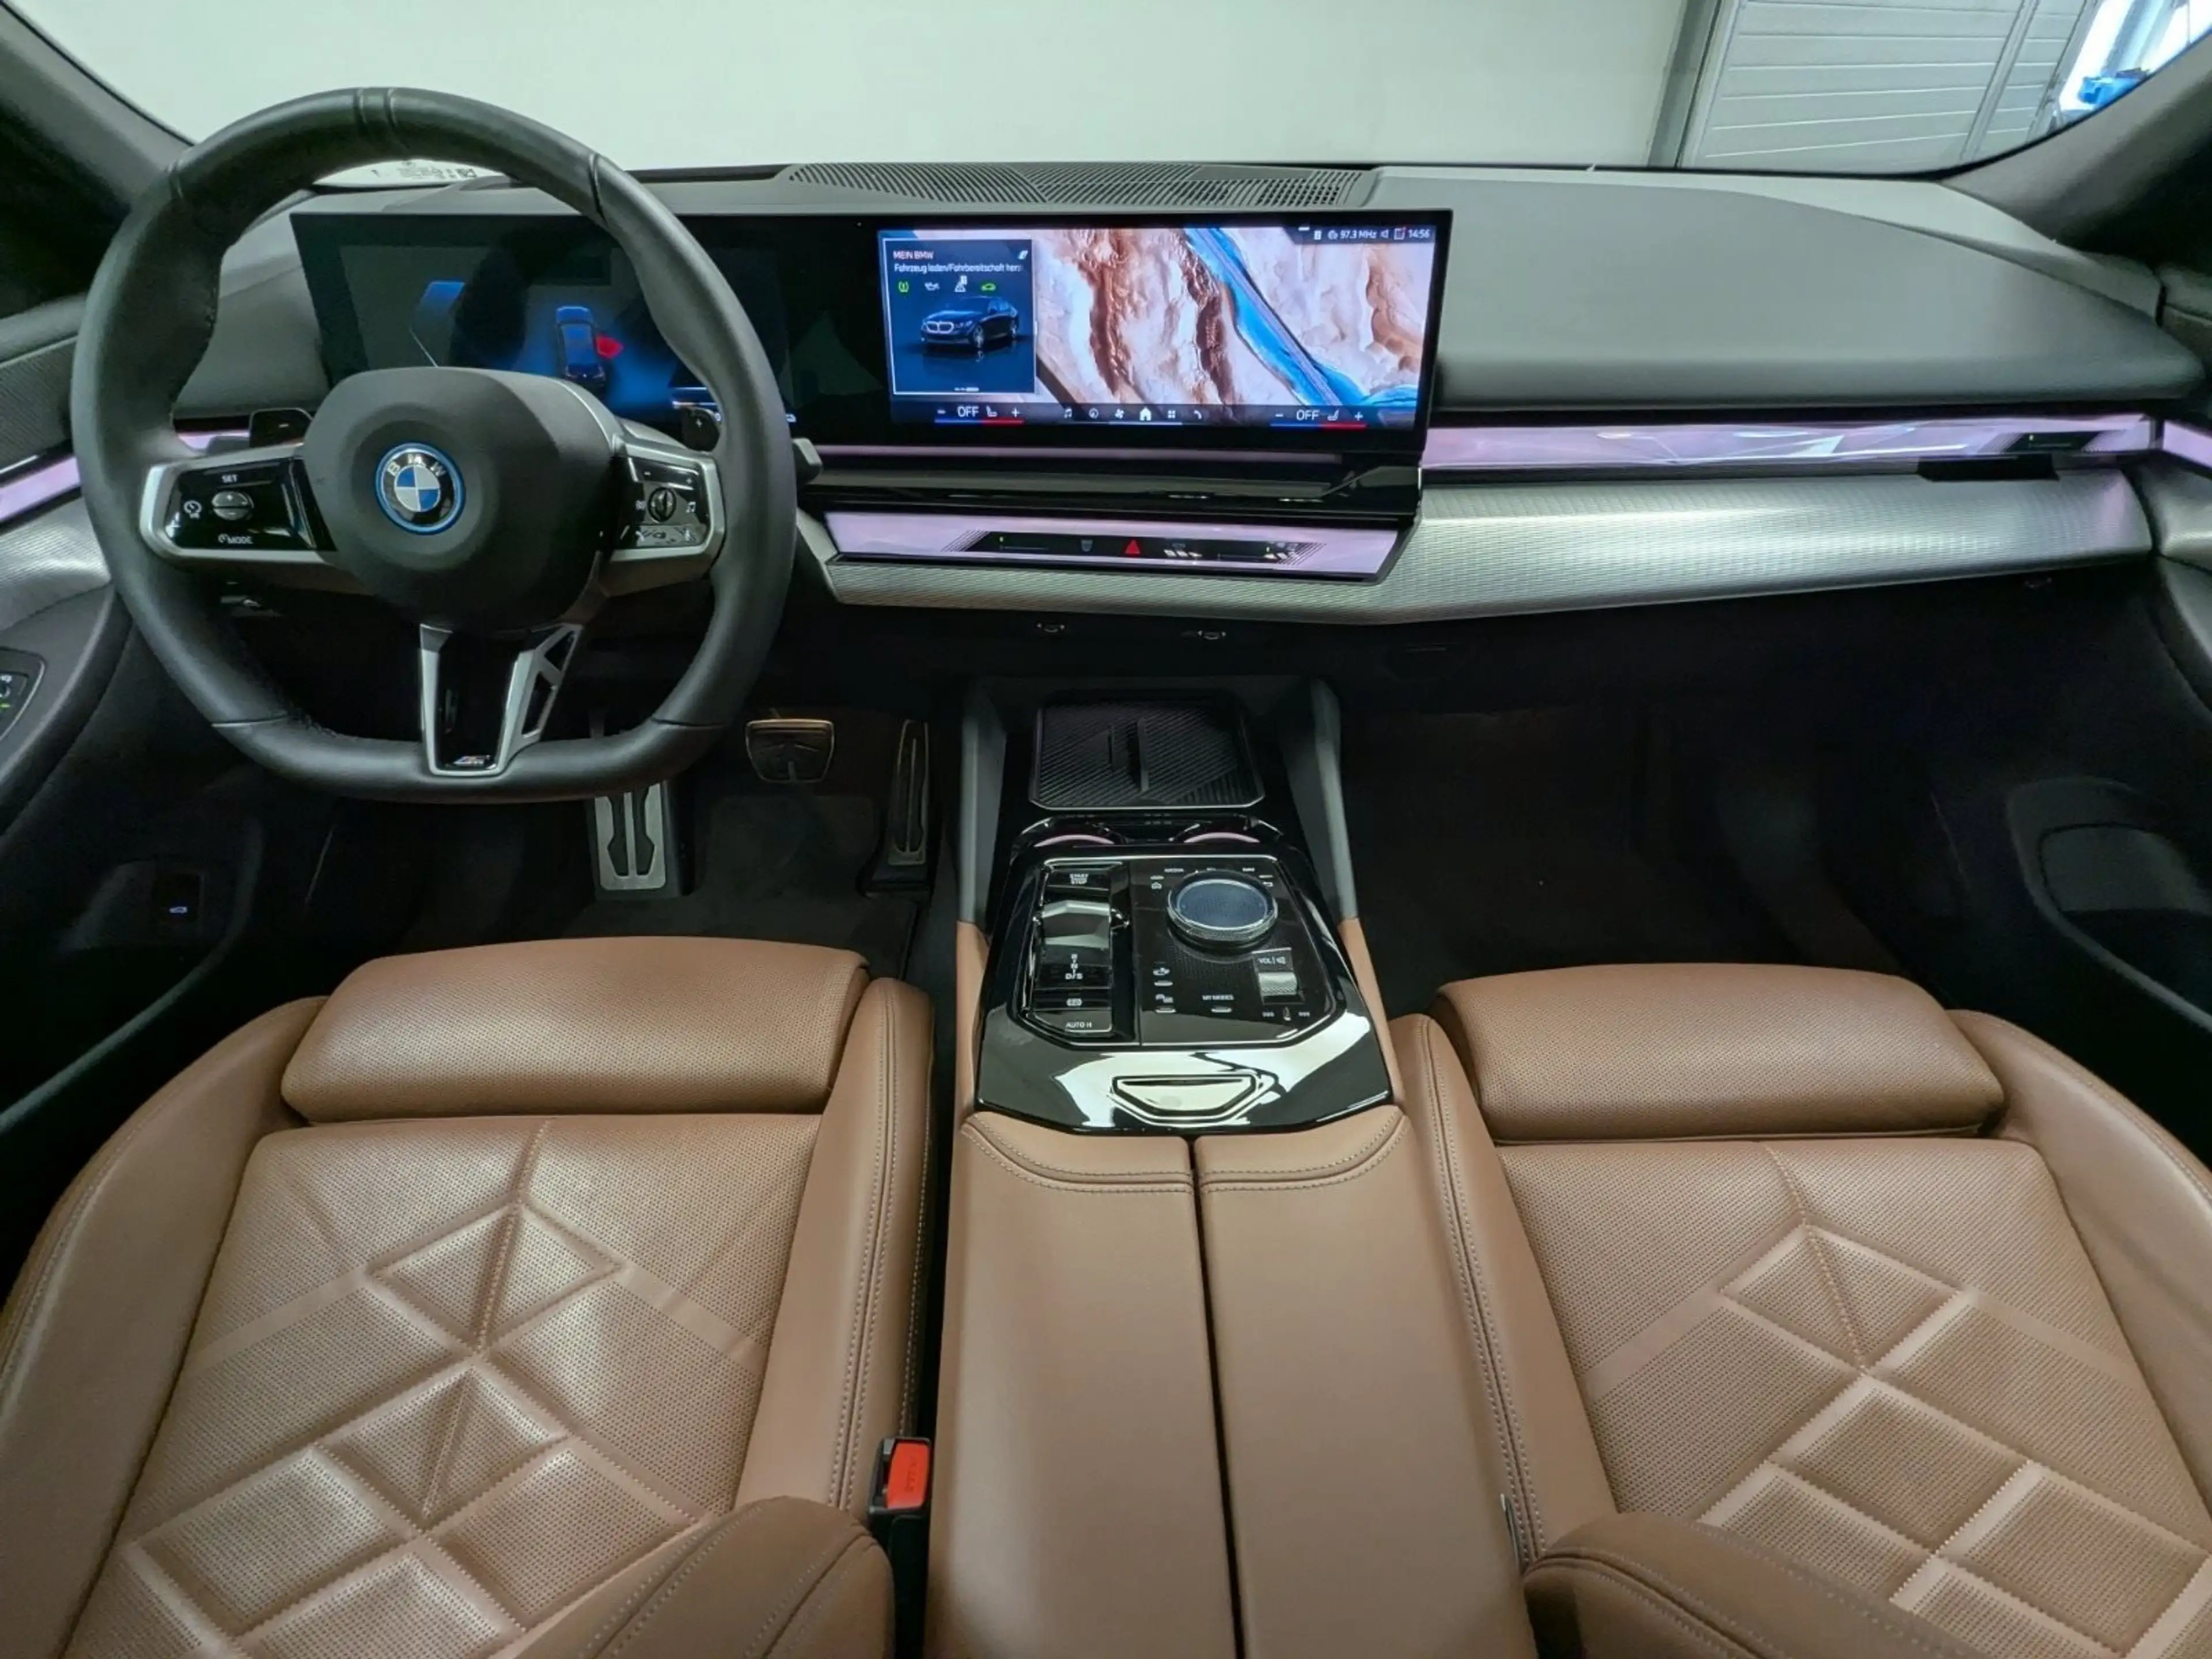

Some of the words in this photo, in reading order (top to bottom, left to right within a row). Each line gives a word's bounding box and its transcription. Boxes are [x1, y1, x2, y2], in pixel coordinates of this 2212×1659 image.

[1358, 230, 1377, 239] MHz
[1408, 229, 1430, 238] 14:56
[893, 250, 913, 259] MEIN
[914, 251, 934, 260] BMW
[894, 263, 927, 275] Fahrzeug
[957, 406, 979, 418] OFF
[1296, 408, 1320, 421] OFF
[387, 453, 446, 477] BMW
[221, 474, 237, 483] SET
[228, 536, 253, 544] MODE
